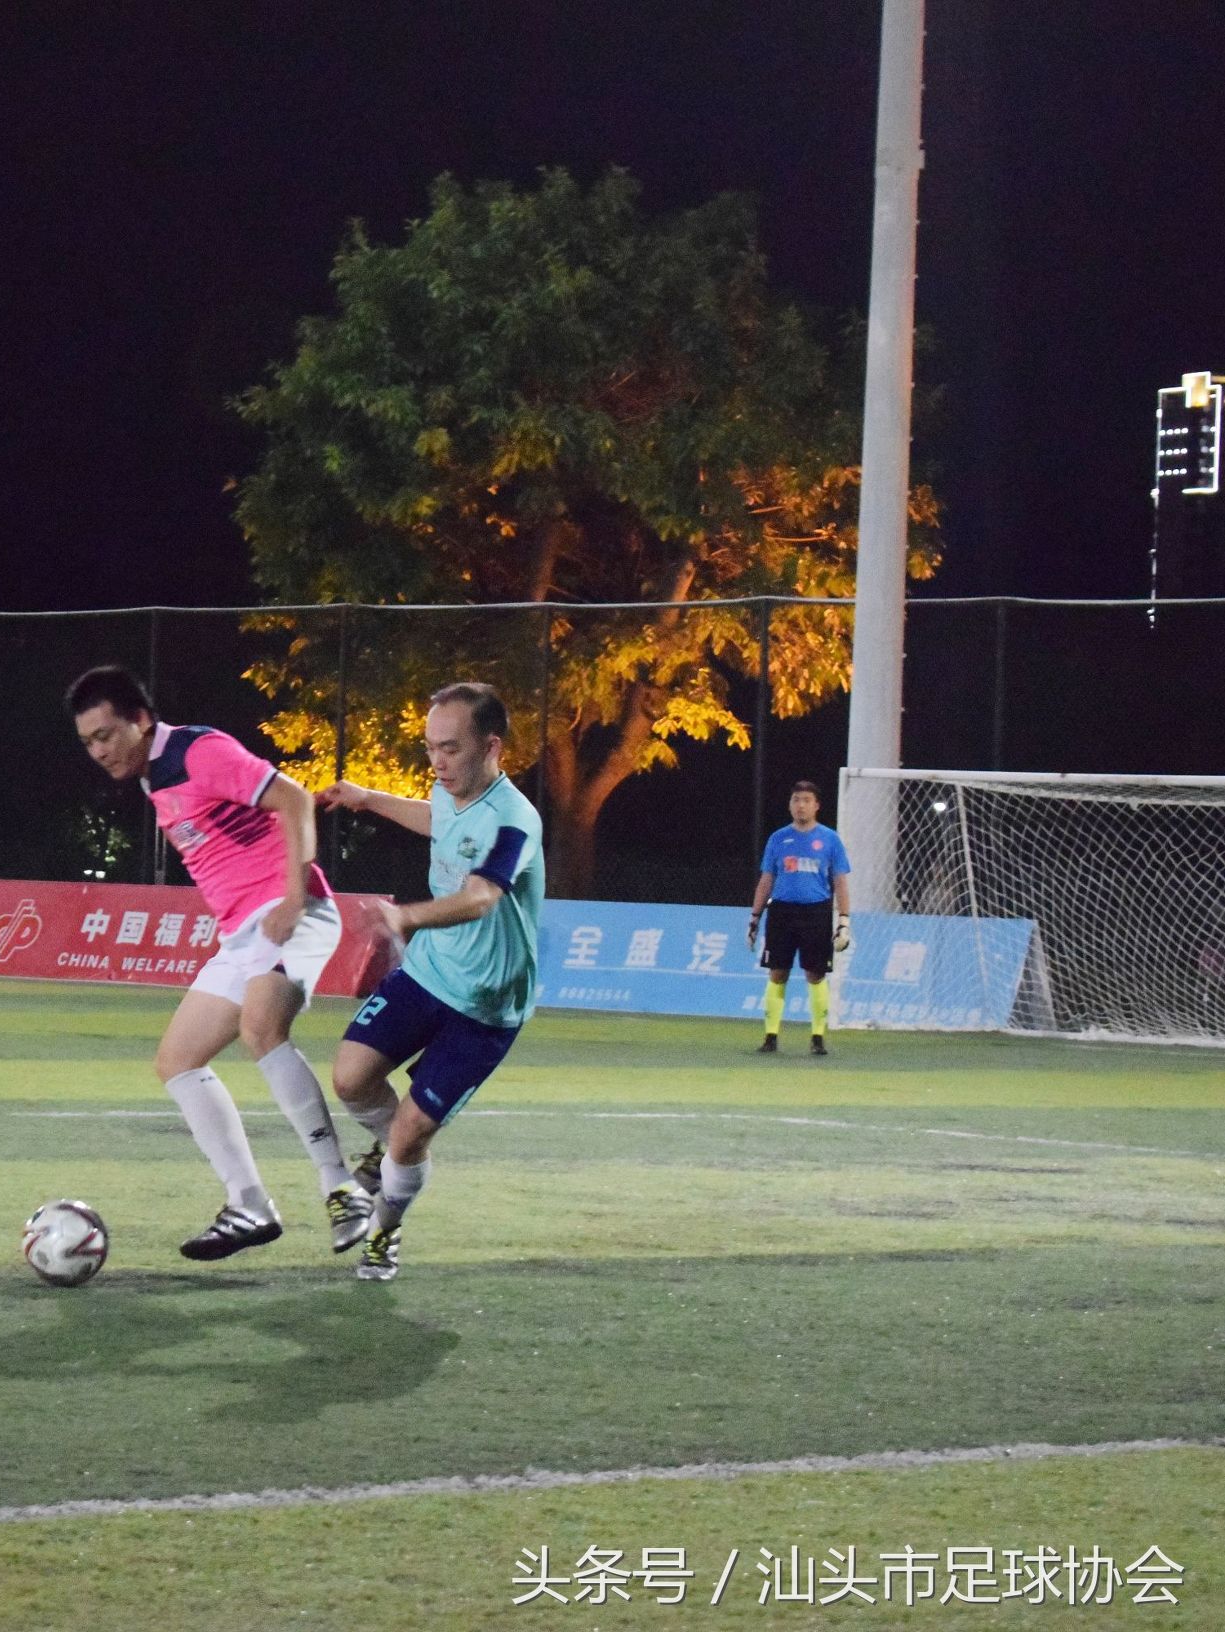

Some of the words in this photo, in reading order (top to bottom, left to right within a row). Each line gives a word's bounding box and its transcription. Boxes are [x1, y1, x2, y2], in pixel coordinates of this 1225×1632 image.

[81, 908, 219, 947] 中国福利
[57, 952, 110, 969] CHINA
[121, 956, 198, 974] WELFARE
